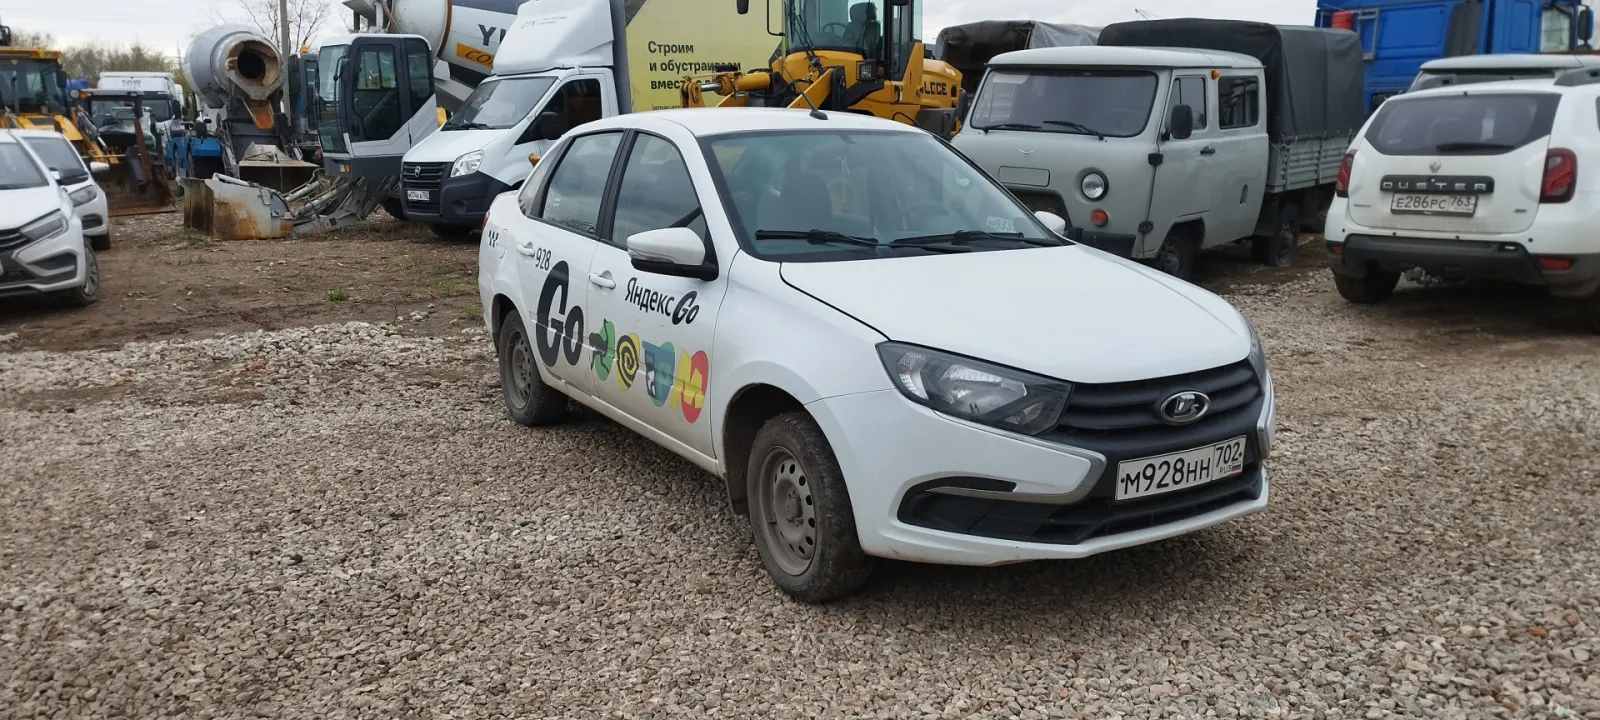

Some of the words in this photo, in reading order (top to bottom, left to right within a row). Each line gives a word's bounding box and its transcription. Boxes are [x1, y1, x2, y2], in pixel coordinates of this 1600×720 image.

[648, 40, 694, 56] Строим
[649, 61, 657, 71] и
[660, 60, 741, 74] обустраим
[1383, 181, 1487, 191] DUSTER
[1451, 196, 1471, 207] 763
[535, 247, 552, 271] 928
[624, 277, 674, 317] Яндекс
[671, 290, 700, 325] Go
[536, 260, 584, 367] Go
[1124, 457, 1211, 495] М928НН
[1215, 441, 1241, 468] 702
[1219, 465, 1232, 475] RUS
